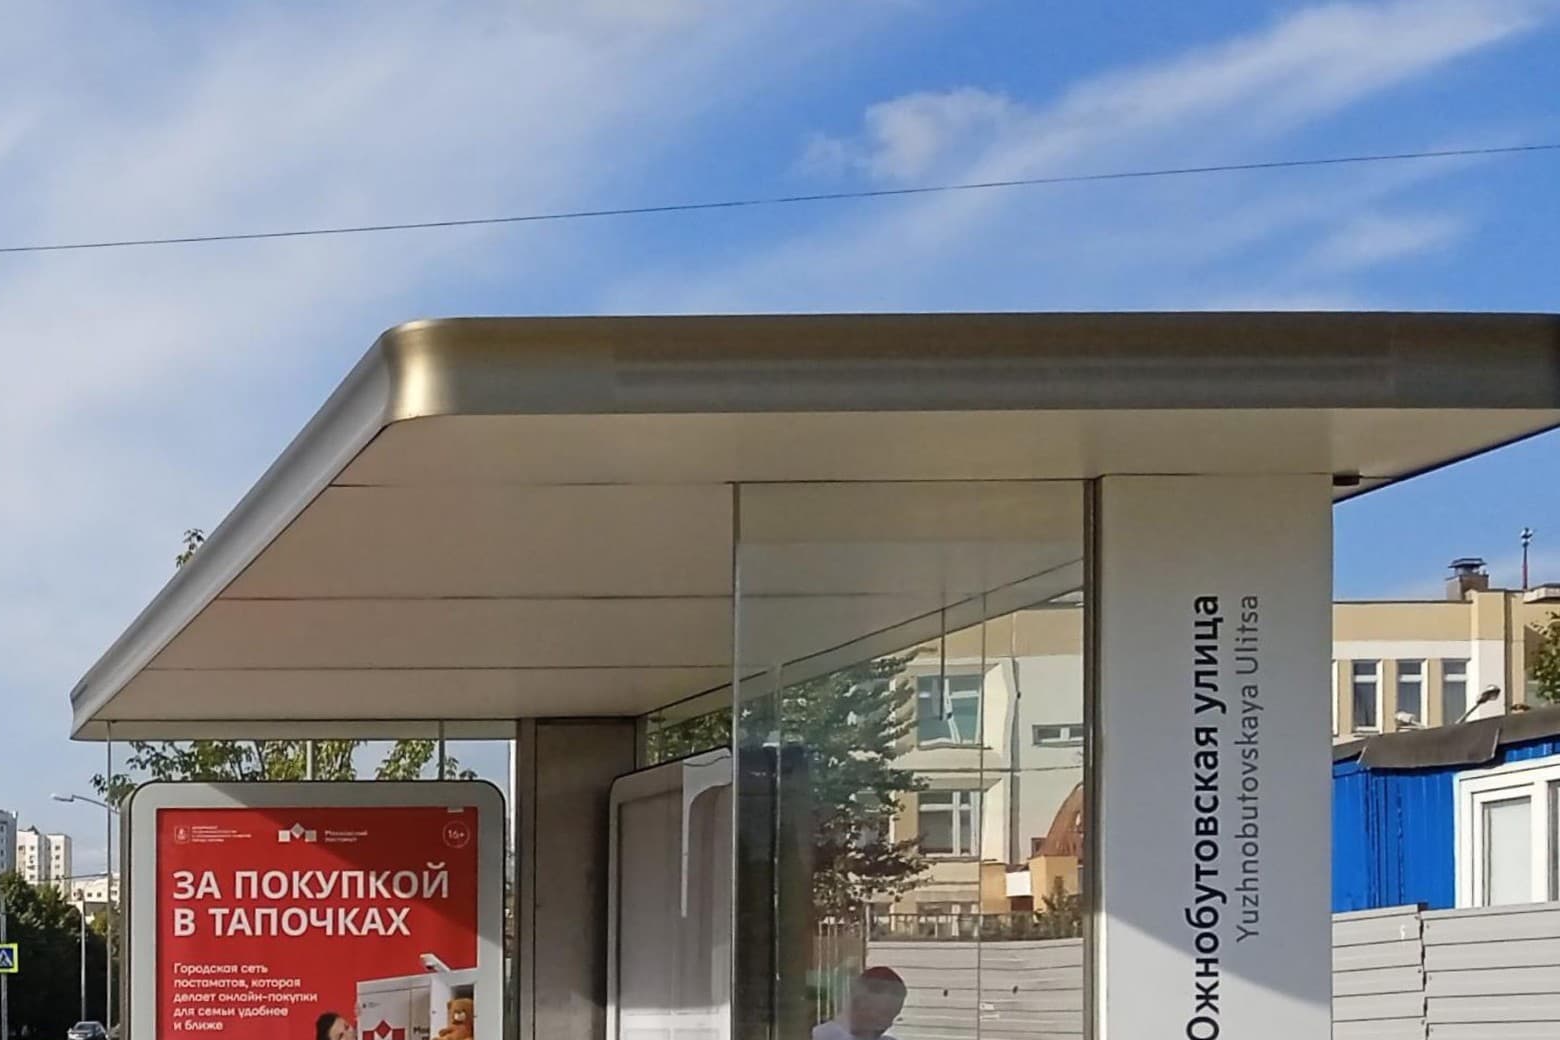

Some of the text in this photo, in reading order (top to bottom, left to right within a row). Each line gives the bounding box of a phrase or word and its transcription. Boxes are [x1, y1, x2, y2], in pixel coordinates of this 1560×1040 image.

[1193, 595, 1227, 715] улица
[1234, 595, 1264, 943] Yuzhnobutovskaya Ulitsa
[172, 861, 449, 900] ЗА ПОКУПКОЙ
[173, 907, 411, 937] В ТАПОЧКАХ
[173, 962, 269, 976] Городская сеть
[173, 978, 301, 990] постаматов, которая
[172, 990, 319, 1004] делает онлайн-покупки
[172, 1004, 289, 1018] для семьи удобнее
[173, 1019, 224, 1031] и ближе
